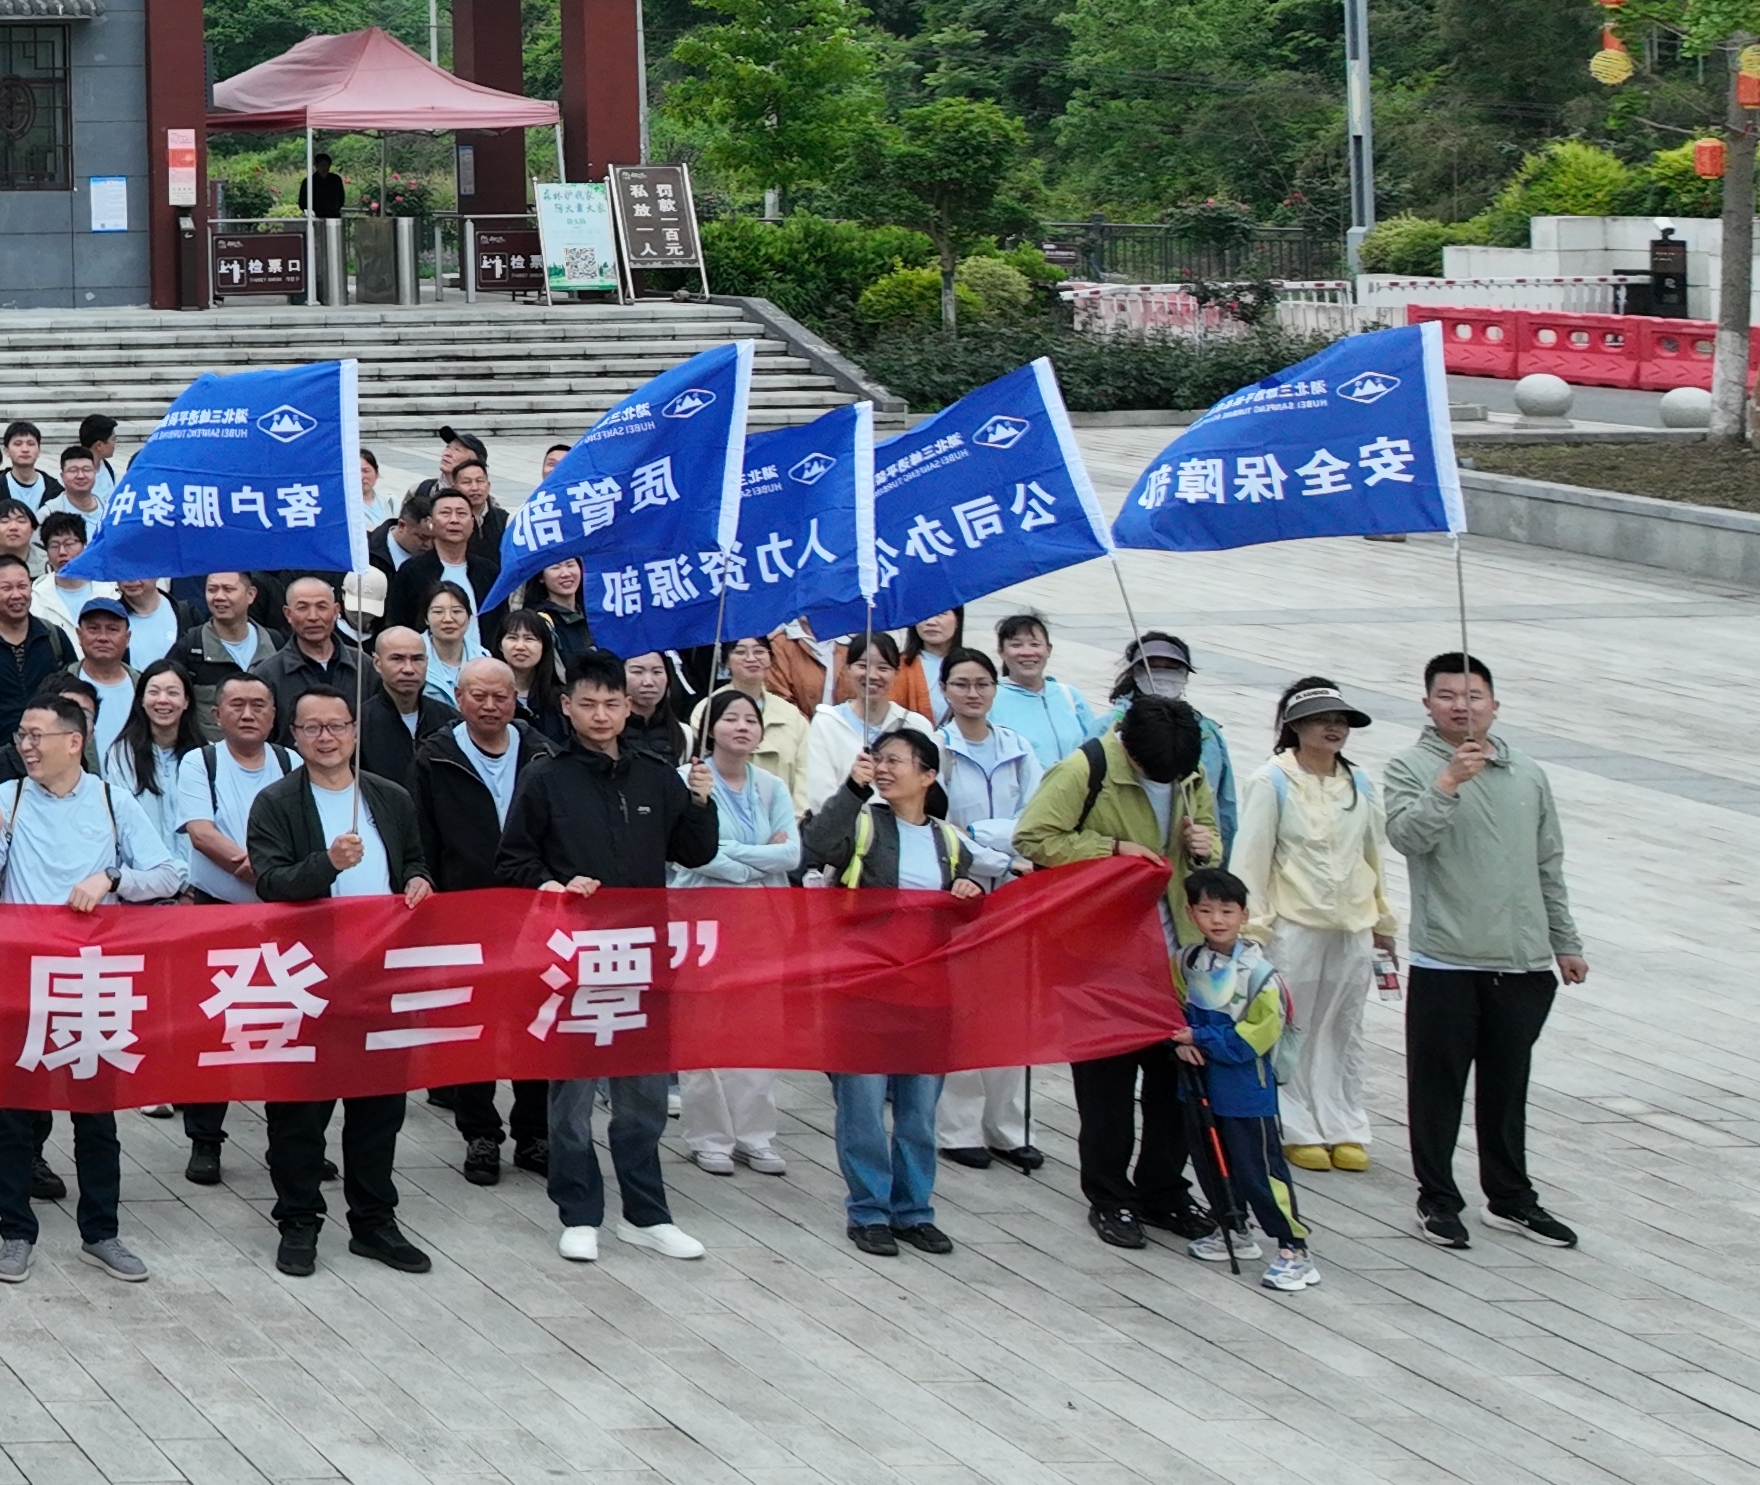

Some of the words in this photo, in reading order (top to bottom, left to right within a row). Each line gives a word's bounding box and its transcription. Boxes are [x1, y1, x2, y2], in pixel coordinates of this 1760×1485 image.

[629, 183, 658, 257] 私放一人
[655, 183, 685, 257] 罚款一百元
[248, 258, 301, 274] 检票口
